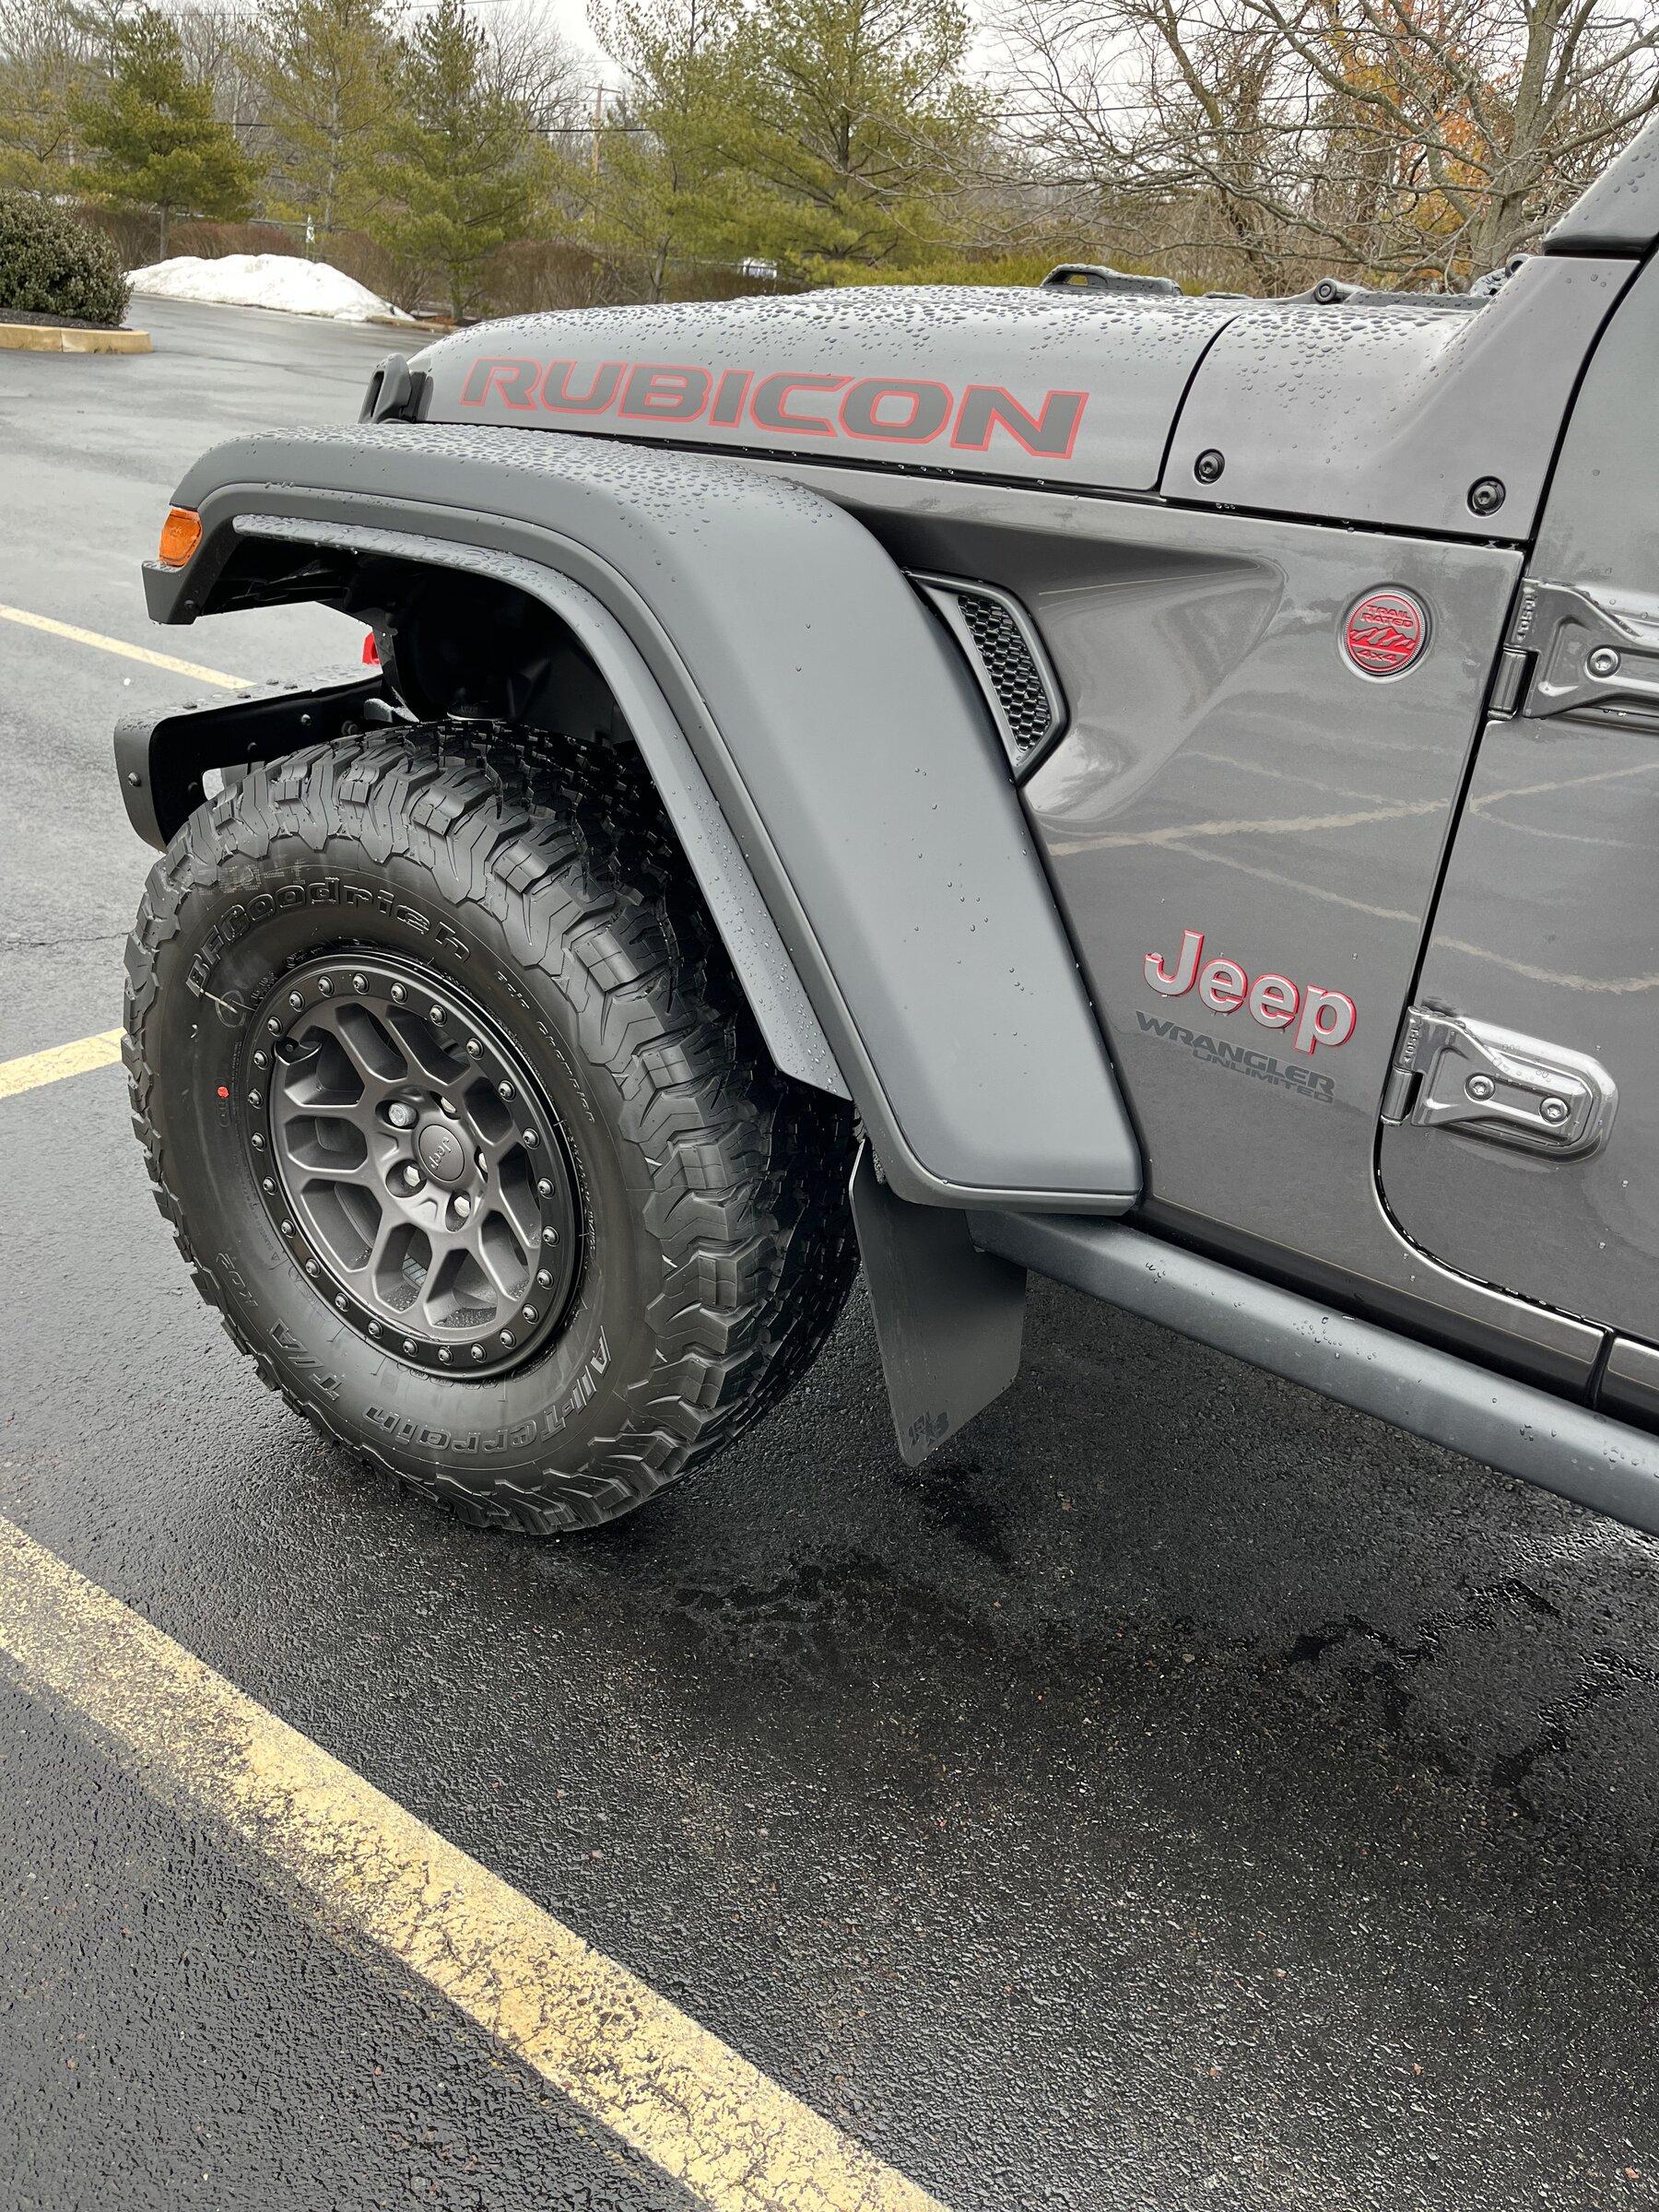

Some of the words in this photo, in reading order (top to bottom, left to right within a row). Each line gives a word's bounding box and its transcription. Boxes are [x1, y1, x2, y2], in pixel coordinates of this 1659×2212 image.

[461, 357, 1089, 459] RUBICON
[1360, 613, 1414, 629] RATED
[1367, 605, 1411, 619] TRAIL
[185, 877, 471, 997] BFGoodrich
[1143, 929, 1357, 1056] Jeep
[1135, 1010, 1335, 1097] WRANGLER
[1192, 1049, 1335, 1103] UNLIMITED
[429, 1136, 452, 1171] Jeep
[268, 1318, 347, 1401] T/A
